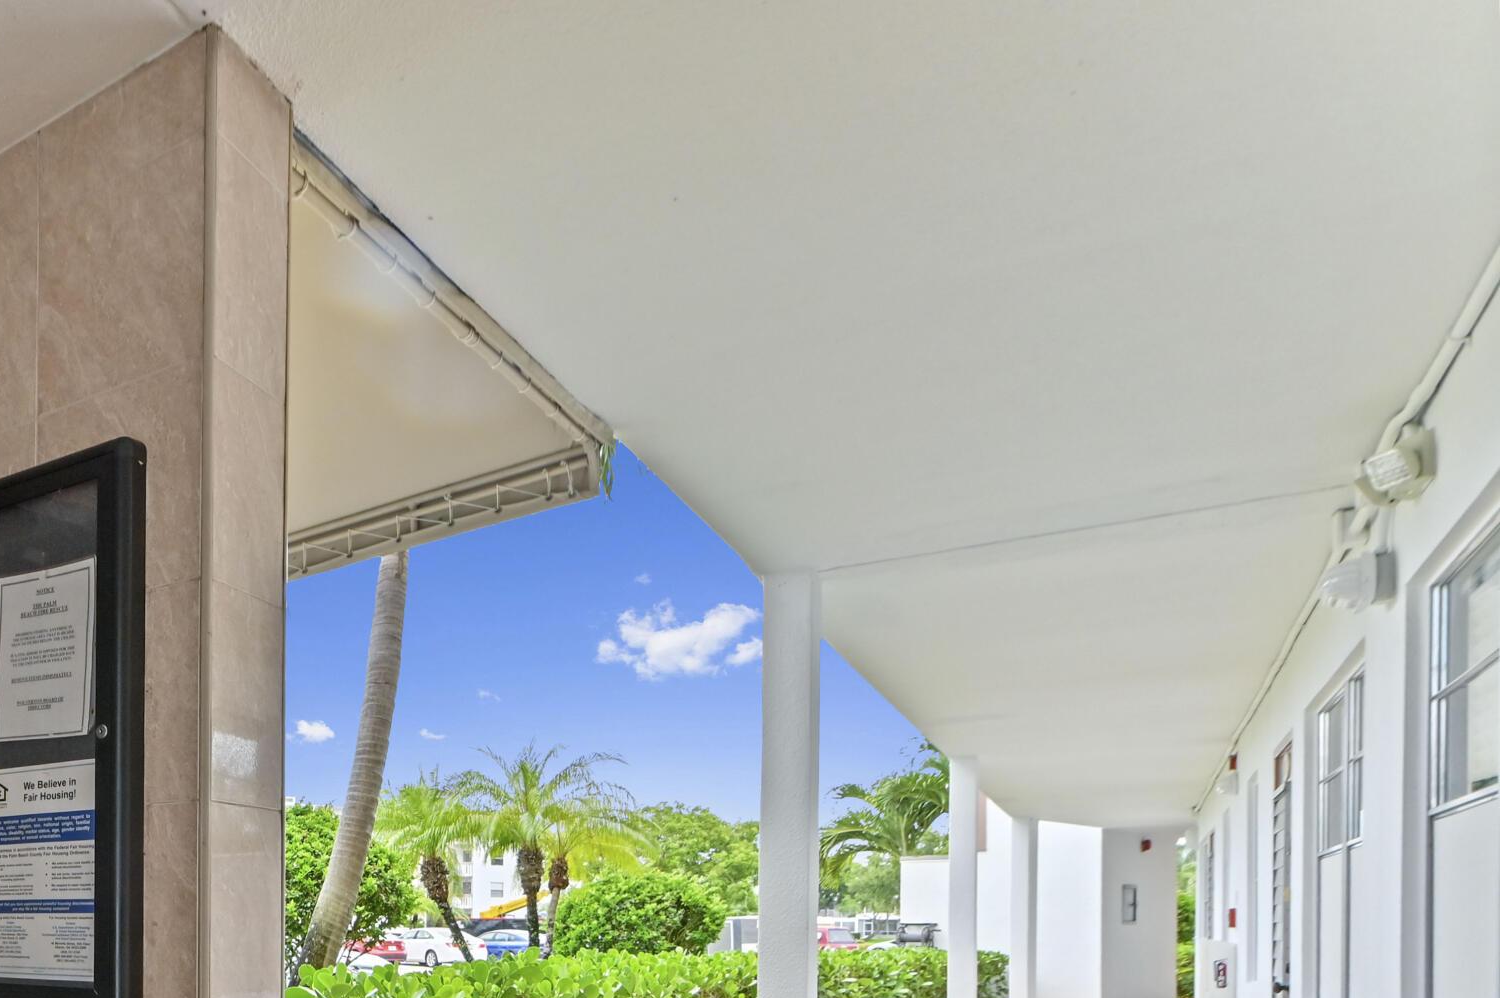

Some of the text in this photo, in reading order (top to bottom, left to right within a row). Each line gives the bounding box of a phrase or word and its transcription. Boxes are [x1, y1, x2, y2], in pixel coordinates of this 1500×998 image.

[24, 778, 76, 790] We Believe in
[24, 789, 76, 802] Fair Housing!
